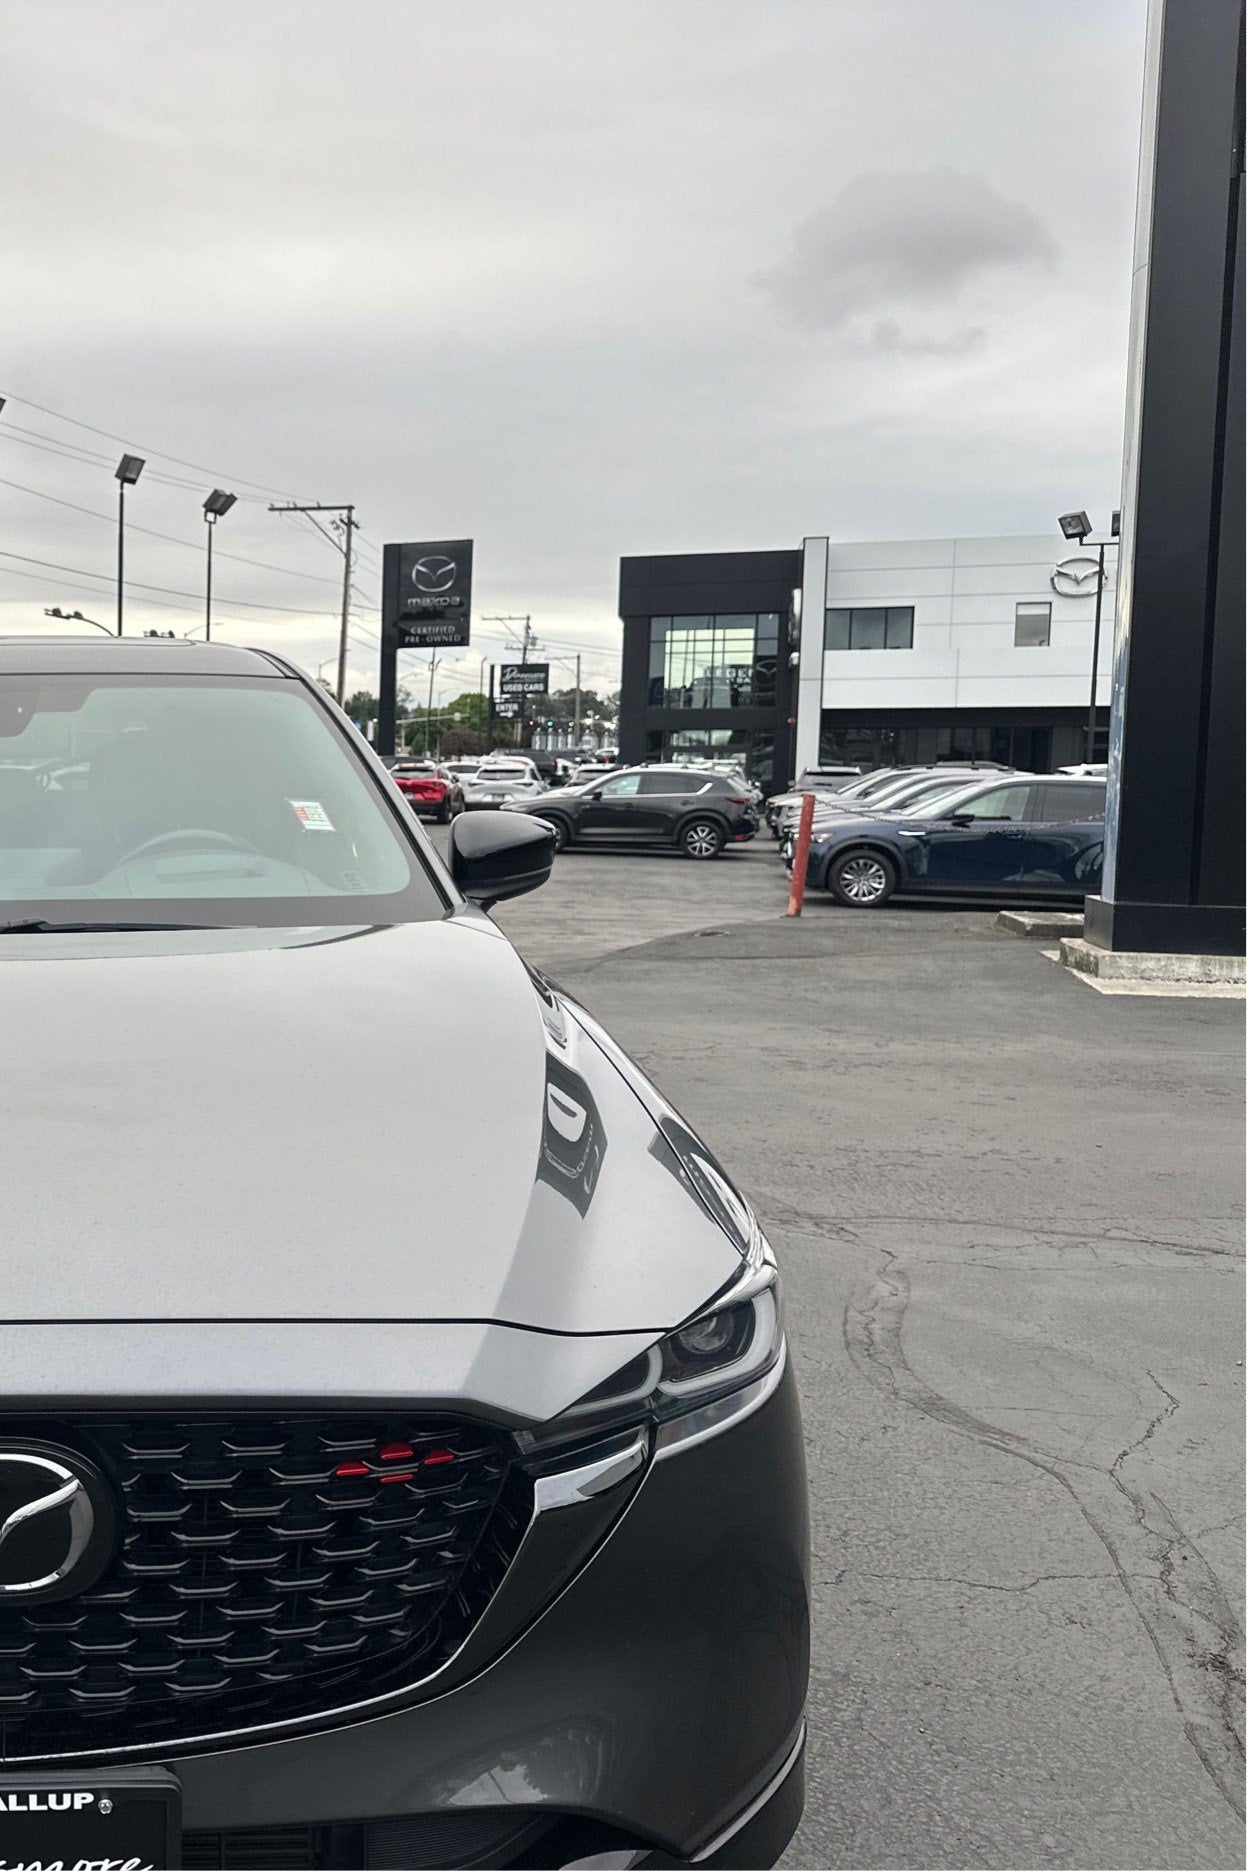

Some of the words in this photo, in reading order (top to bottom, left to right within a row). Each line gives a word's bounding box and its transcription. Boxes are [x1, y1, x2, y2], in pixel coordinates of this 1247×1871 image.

[410, 624, 456, 635] CERTIFIED
[503, 683, 522, 692] USED
[523, 683, 544, 692] CARS
[495, 703, 519, 712] ENTER
